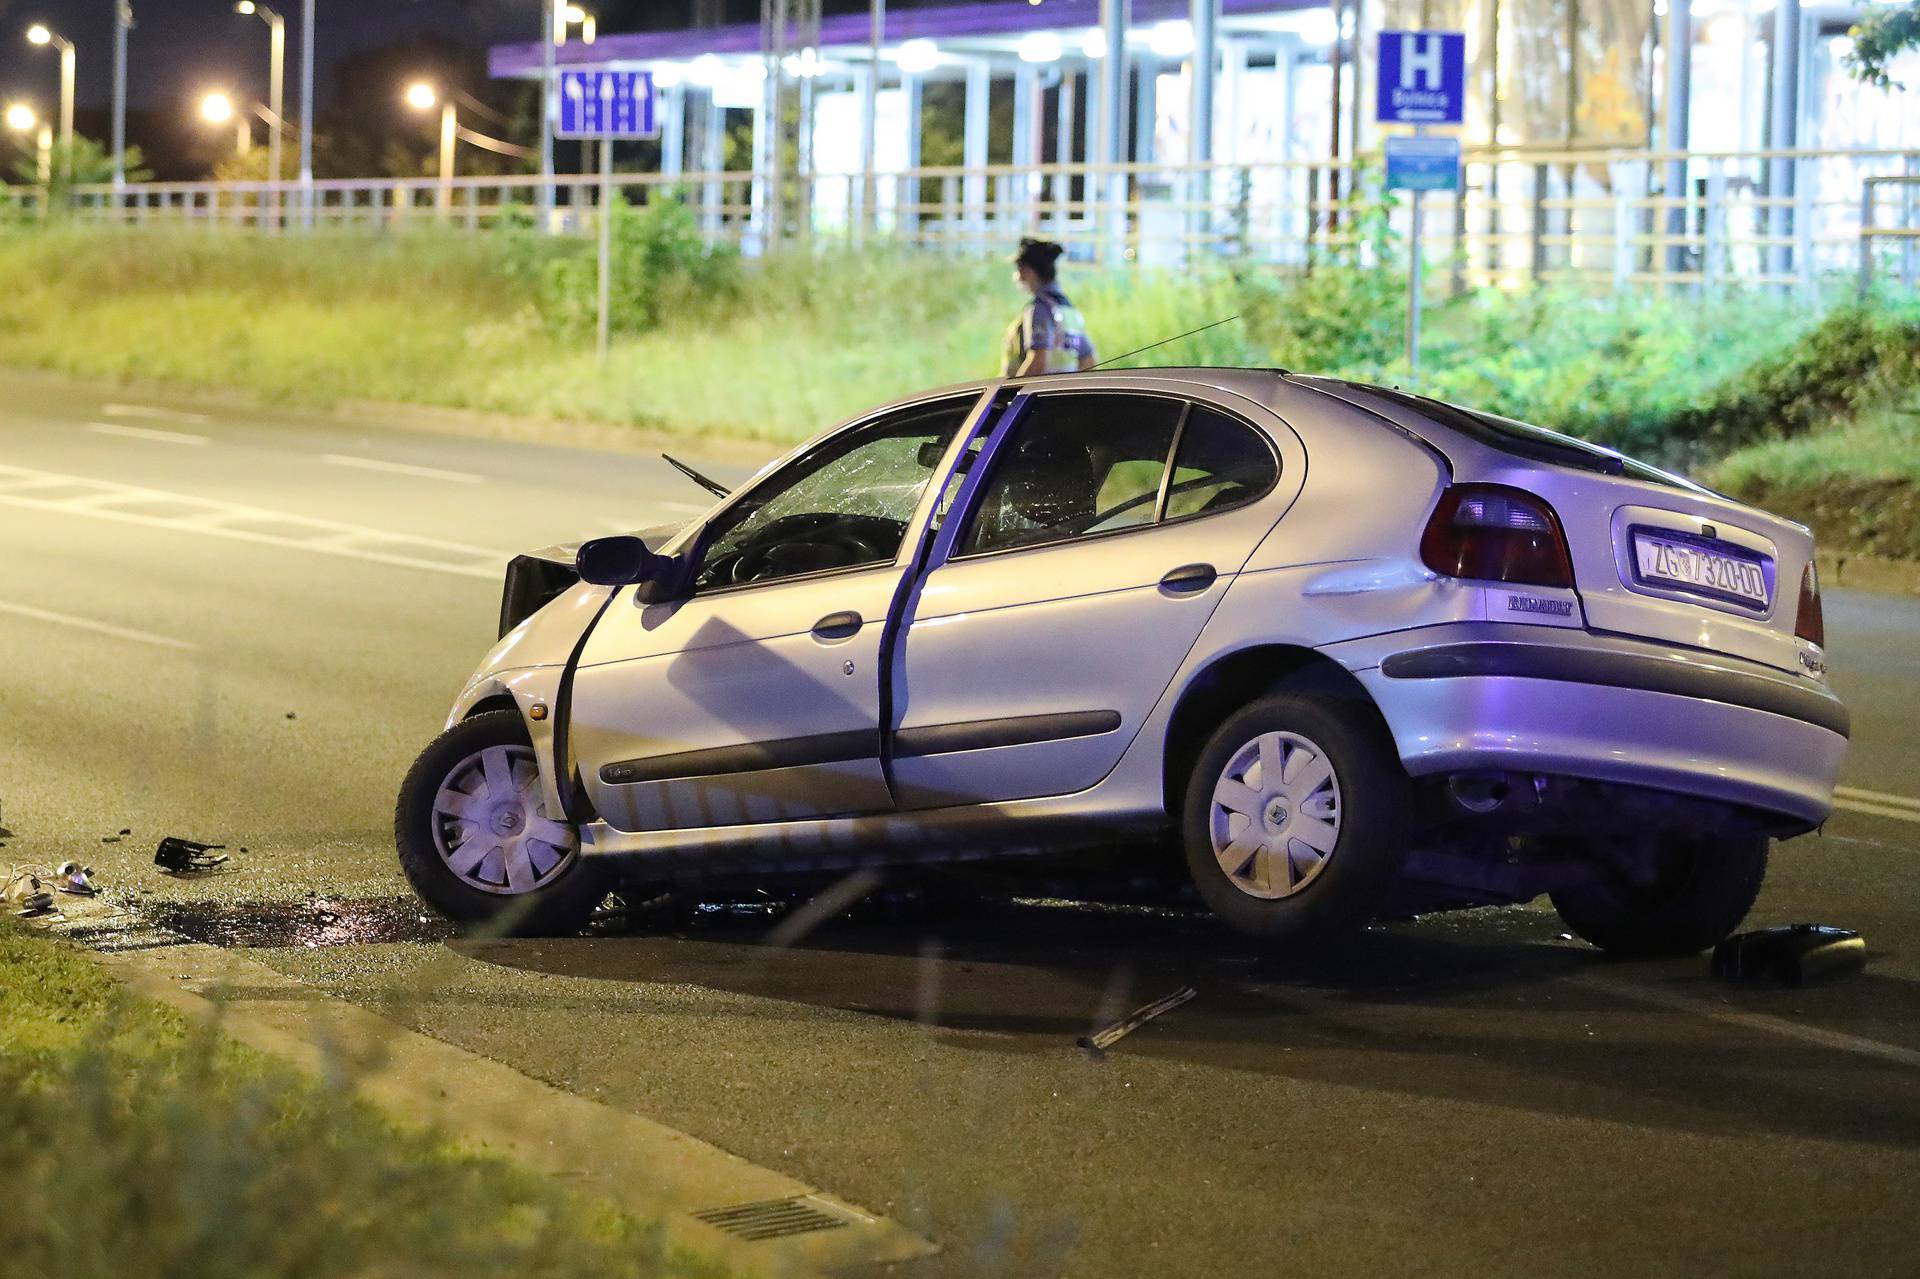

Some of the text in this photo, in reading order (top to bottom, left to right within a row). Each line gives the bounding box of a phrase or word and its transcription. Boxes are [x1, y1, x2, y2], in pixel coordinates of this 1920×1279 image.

[1400, 34, 1442, 90] H
[1652, 543, 1679, 577] ZG
[1508, 595, 1573, 616] RENAULT
